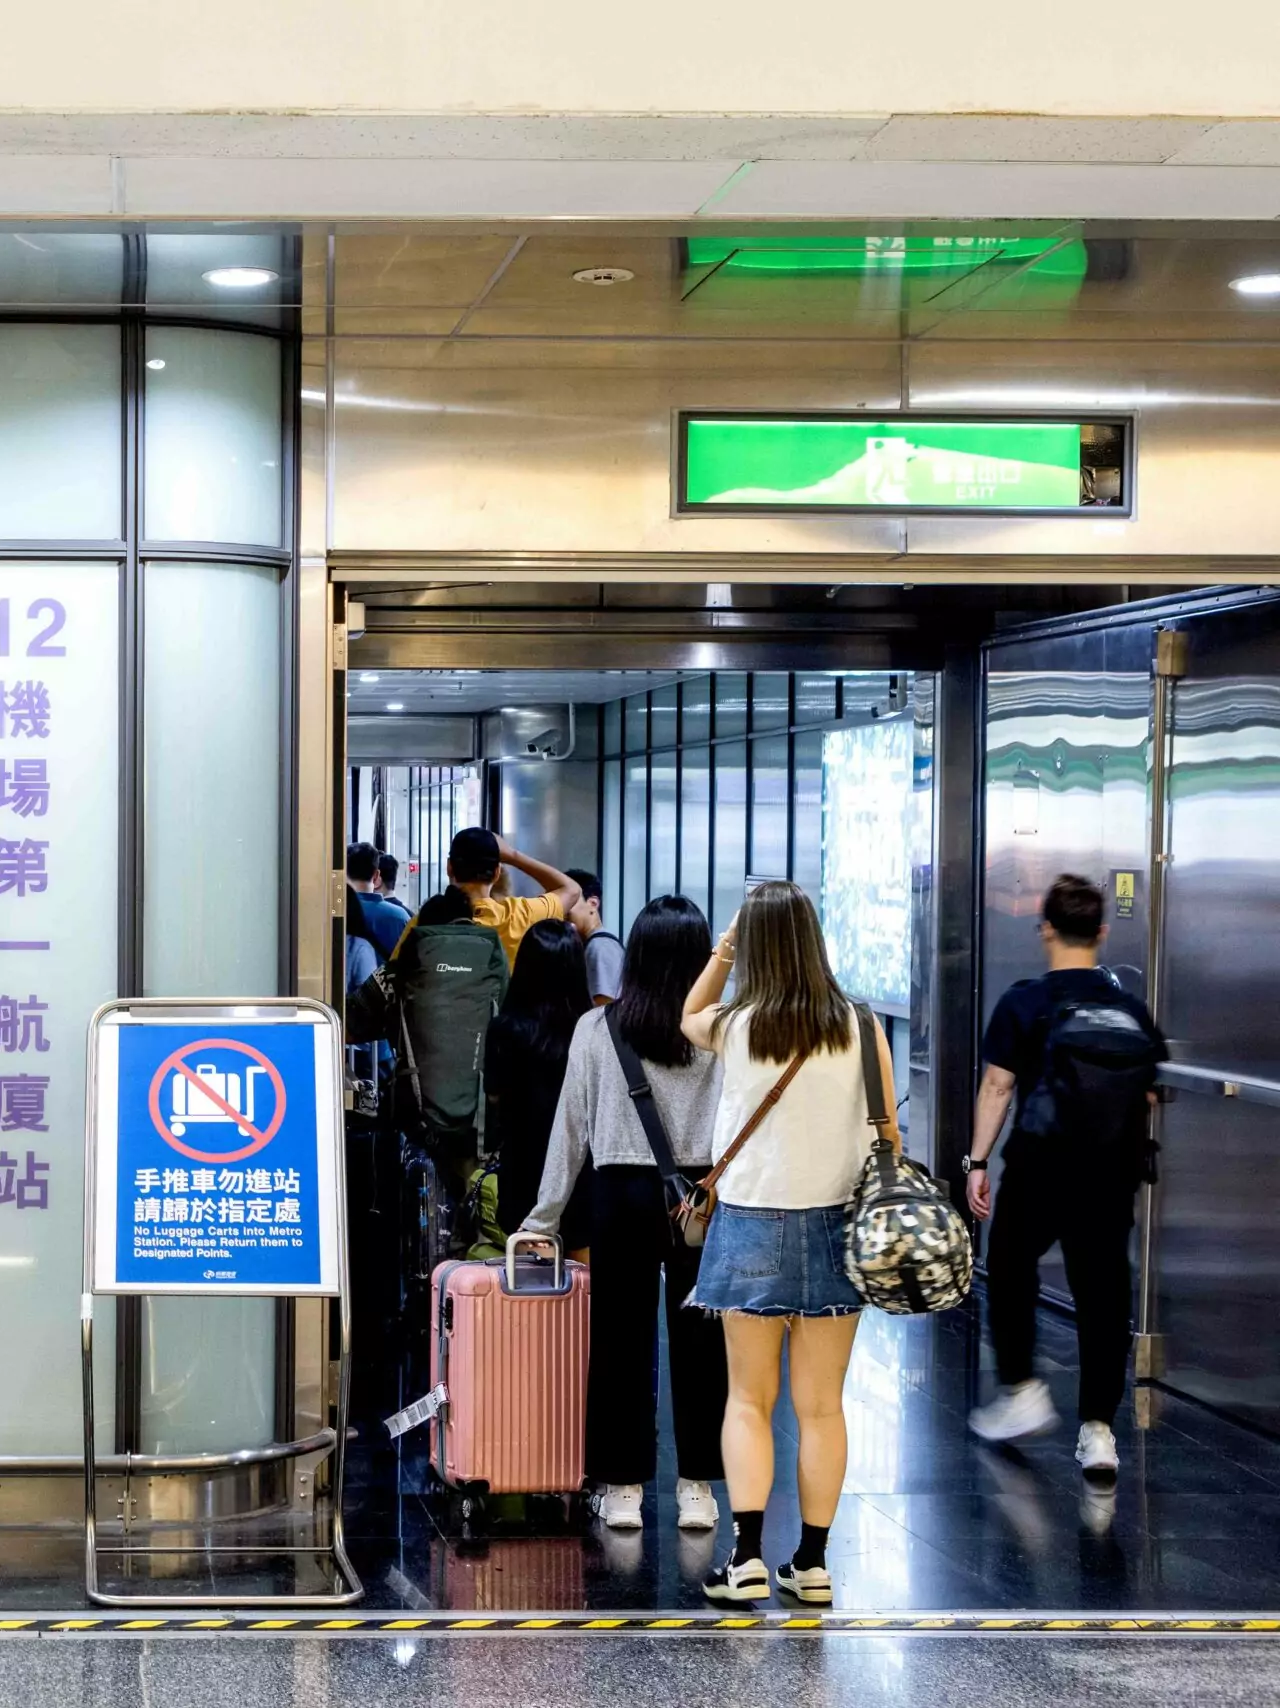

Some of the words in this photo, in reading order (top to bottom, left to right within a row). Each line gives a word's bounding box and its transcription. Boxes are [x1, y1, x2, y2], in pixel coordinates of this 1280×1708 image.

[134, 1168, 301, 1194] 手推車勿進站
[134, 1197, 301, 1223] 請歸於指定處
[134, 1226, 150, 1236] No
[154, 1226, 204, 1239] Luggage
[208, 1226, 240, 1237] Carts
[269, 1226, 303, 1237] Metro
[134, 1236, 176, 1247] Station.
[180, 1237, 217, 1247] Please
[220, 1237, 257, 1247] Return
[260, 1237, 289, 1247] them
[291, 1237, 303, 1247] to
[134, 1248, 193, 1260] Designated
[196, 1248, 233, 1259] Points.
